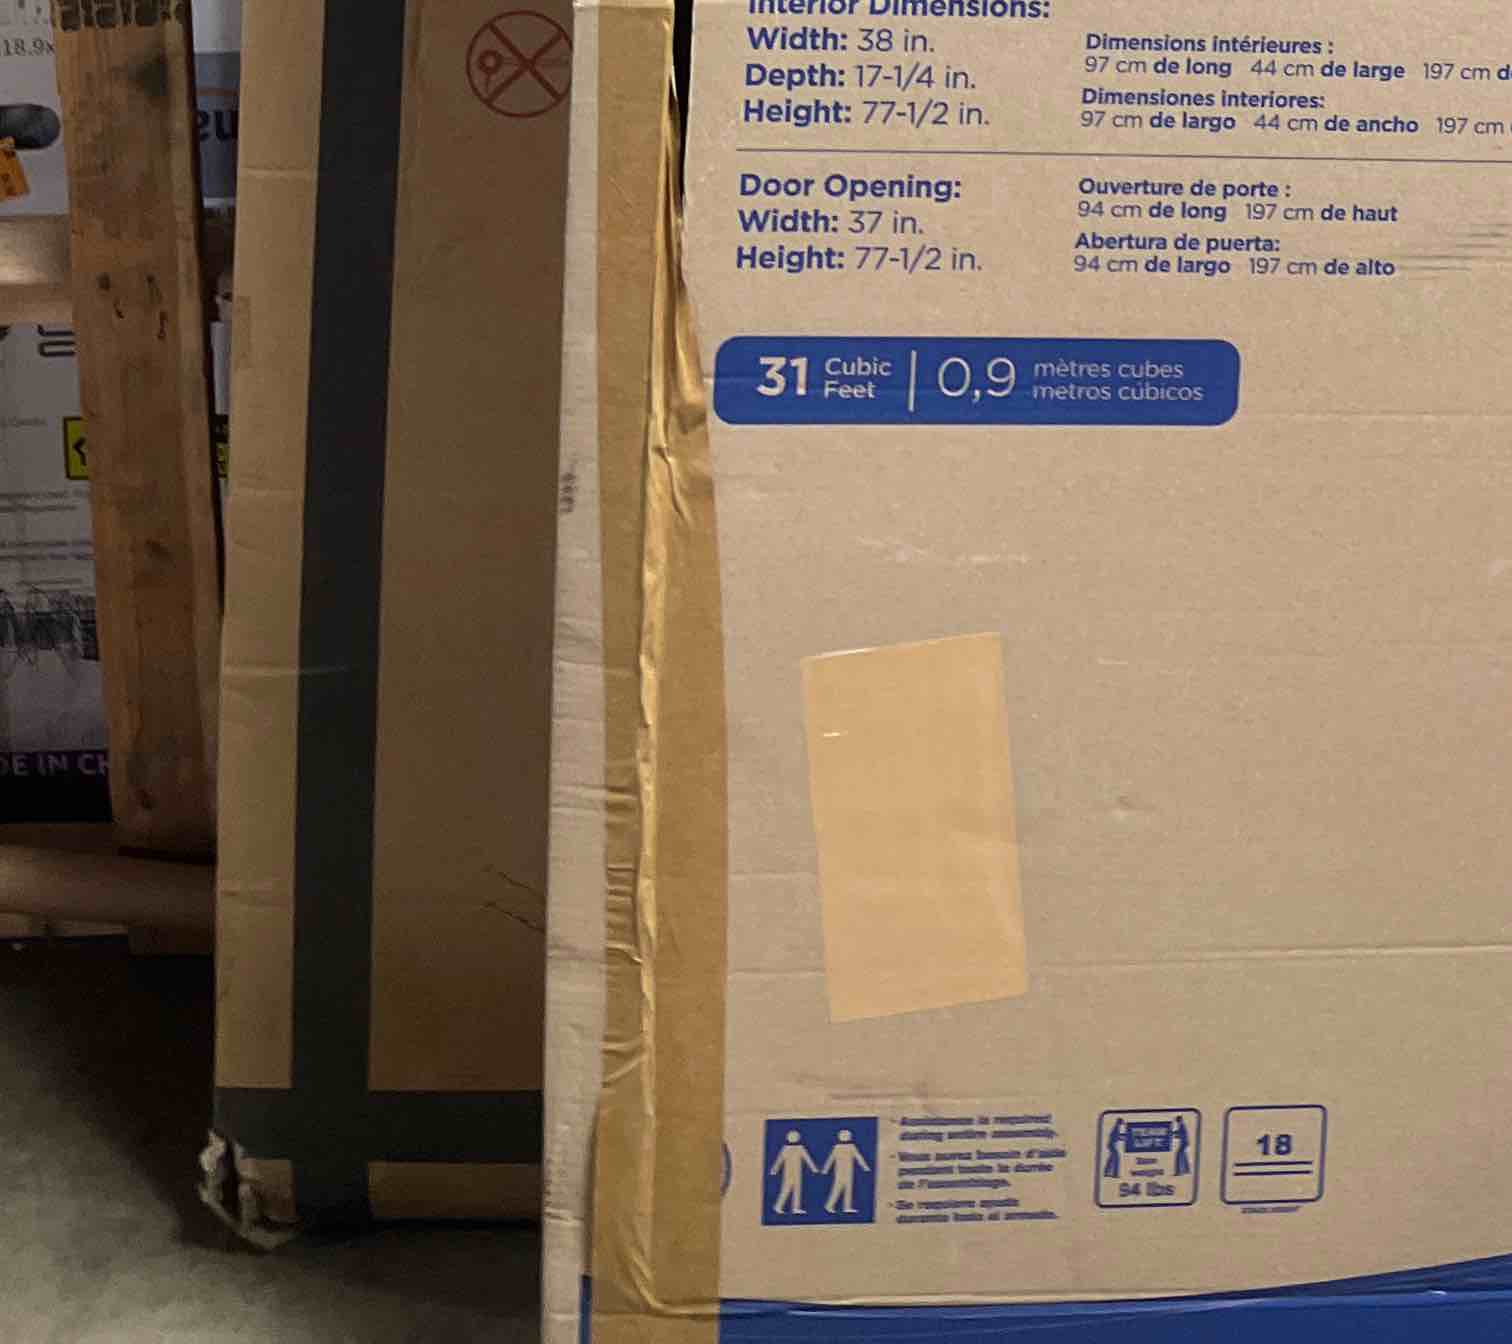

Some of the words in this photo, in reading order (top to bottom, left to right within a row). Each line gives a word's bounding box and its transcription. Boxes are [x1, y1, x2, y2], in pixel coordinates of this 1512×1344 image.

[747, 27, 847, 50] Width:
[858, 29, 892, 51] 38
[904, 29, 934, 52] in.
[746, 63, 844, 91] Depth:
[856, 62, 934, 91] 17-1/4
[946, 66, 975, 88] in.
[744, 99, 851, 127] Height:
[863, 99, 948, 128] 77-1/2
[960, 102, 989, 124] in.
[740, 174, 814, 196] Door
[824, 174, 961, 202] Opening:
[738, 209, 838, 232] Width:
[848, 210, 882, 233] 37
[894, 210, 923, 234] in.
[737, 245, 844, 273] Height:
[856, 245, 941, 273] 77-1/2
[952, 248, 981, 270] in.
[757, 357, 807, 395] 31
[825, 357, 891, 376] Cubic
[1035, 359, 1110, 377] mètres
[1118, 360, 1183, 378] cubes
[824, 381, 875, 398] Feet
[939, 358, 1015, 402] 0,9
[1033, 384, 1111, 400] metros
[1118, 382, 1203, 400] cúbicos
[1256, 1134, 1291, 1155] 18
